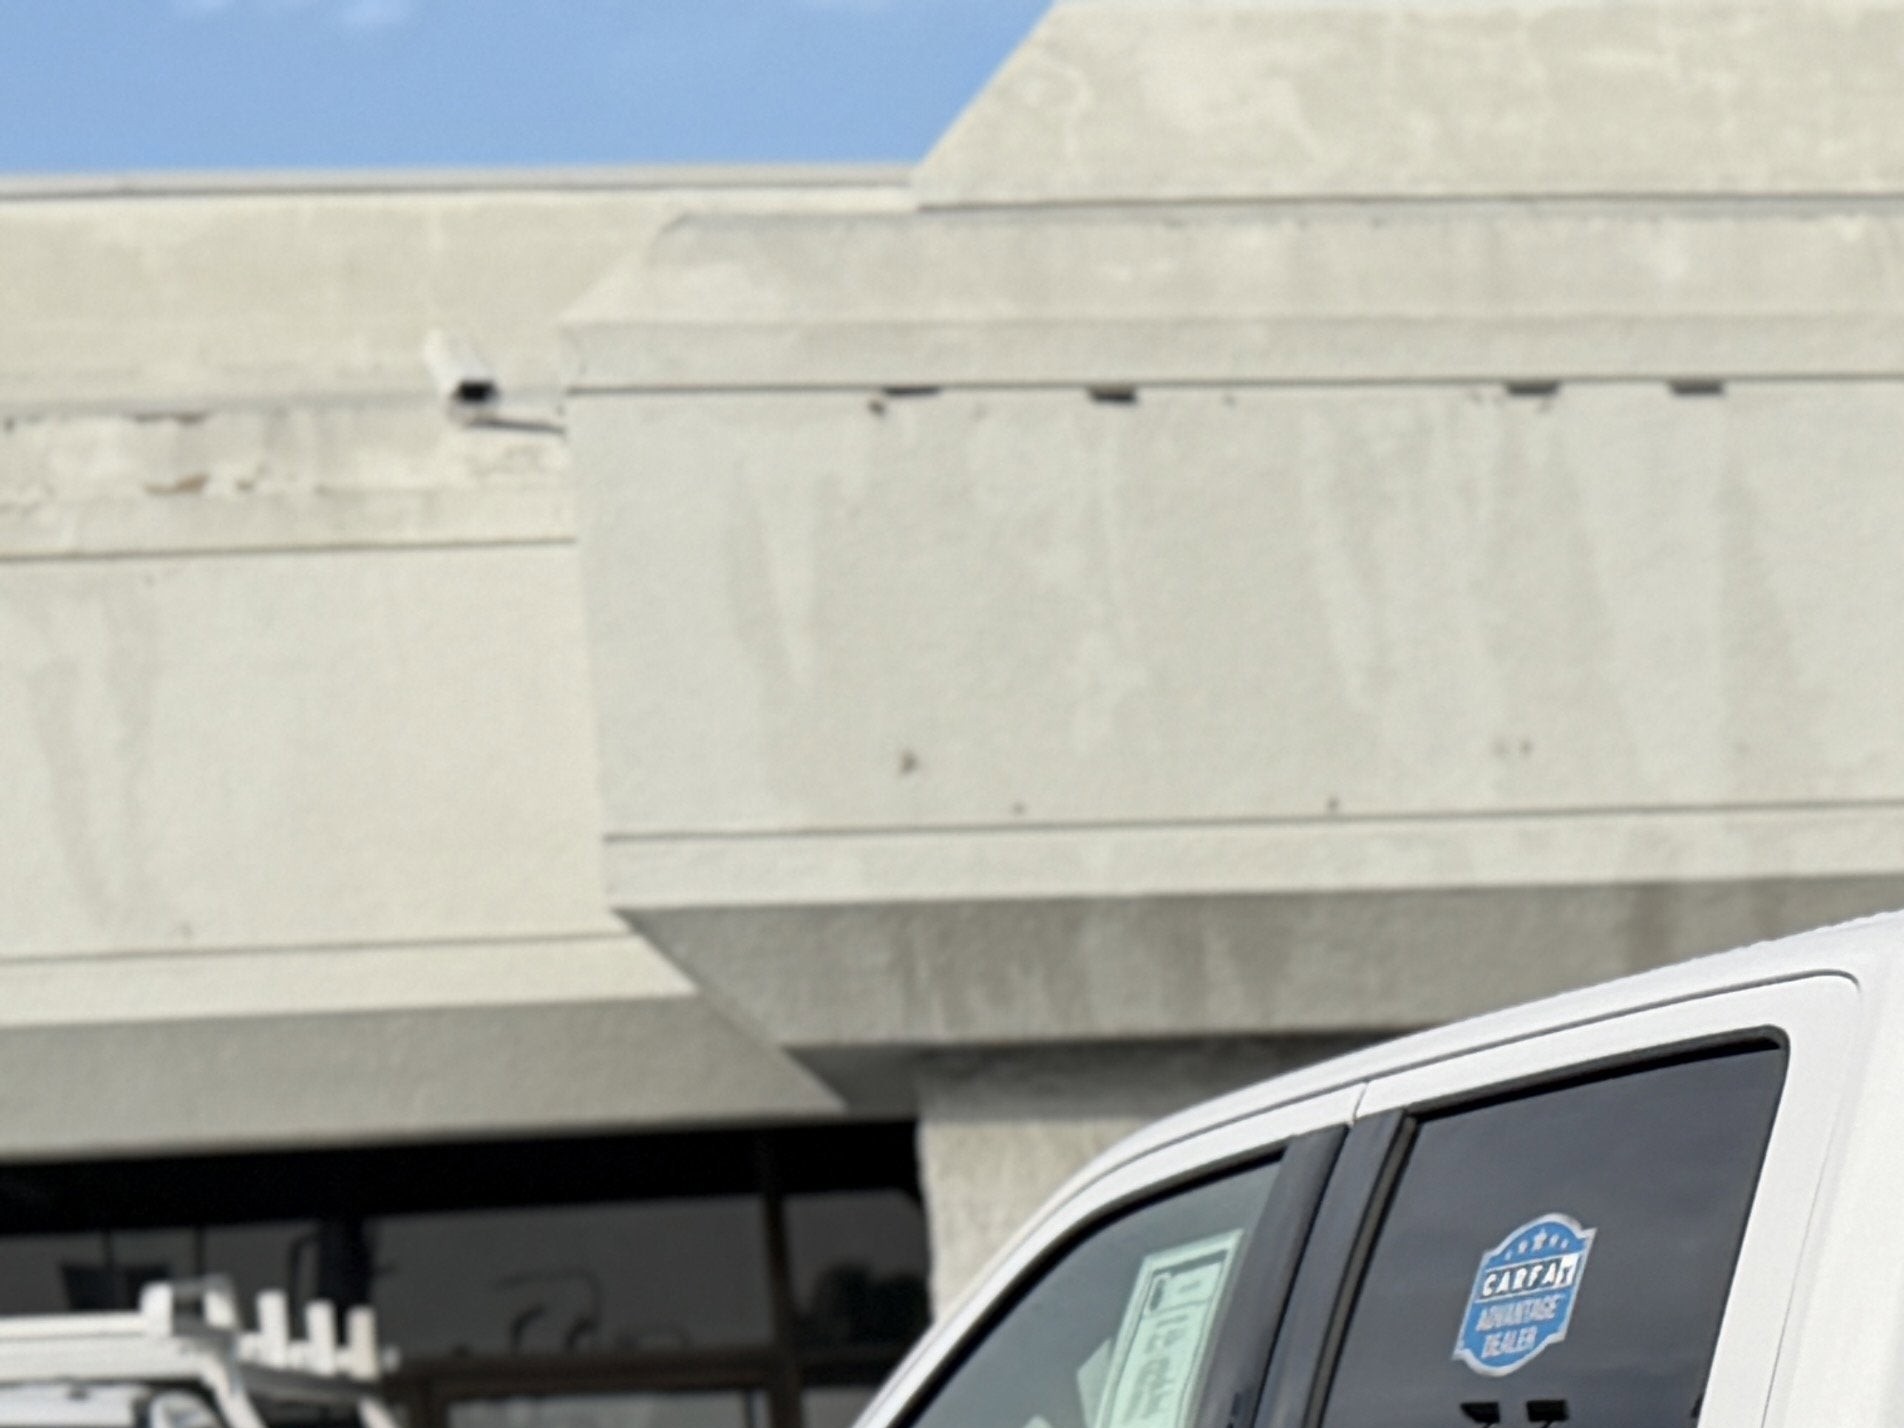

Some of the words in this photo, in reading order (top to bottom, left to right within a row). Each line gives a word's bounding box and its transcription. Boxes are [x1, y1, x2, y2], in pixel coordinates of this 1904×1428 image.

[1481, 1258, 1575, 1297] CARFAX
[1476, 1294, 1561, 1331] ADVANTAGE
[1481, 1326, 1539, 1359] DEALER
